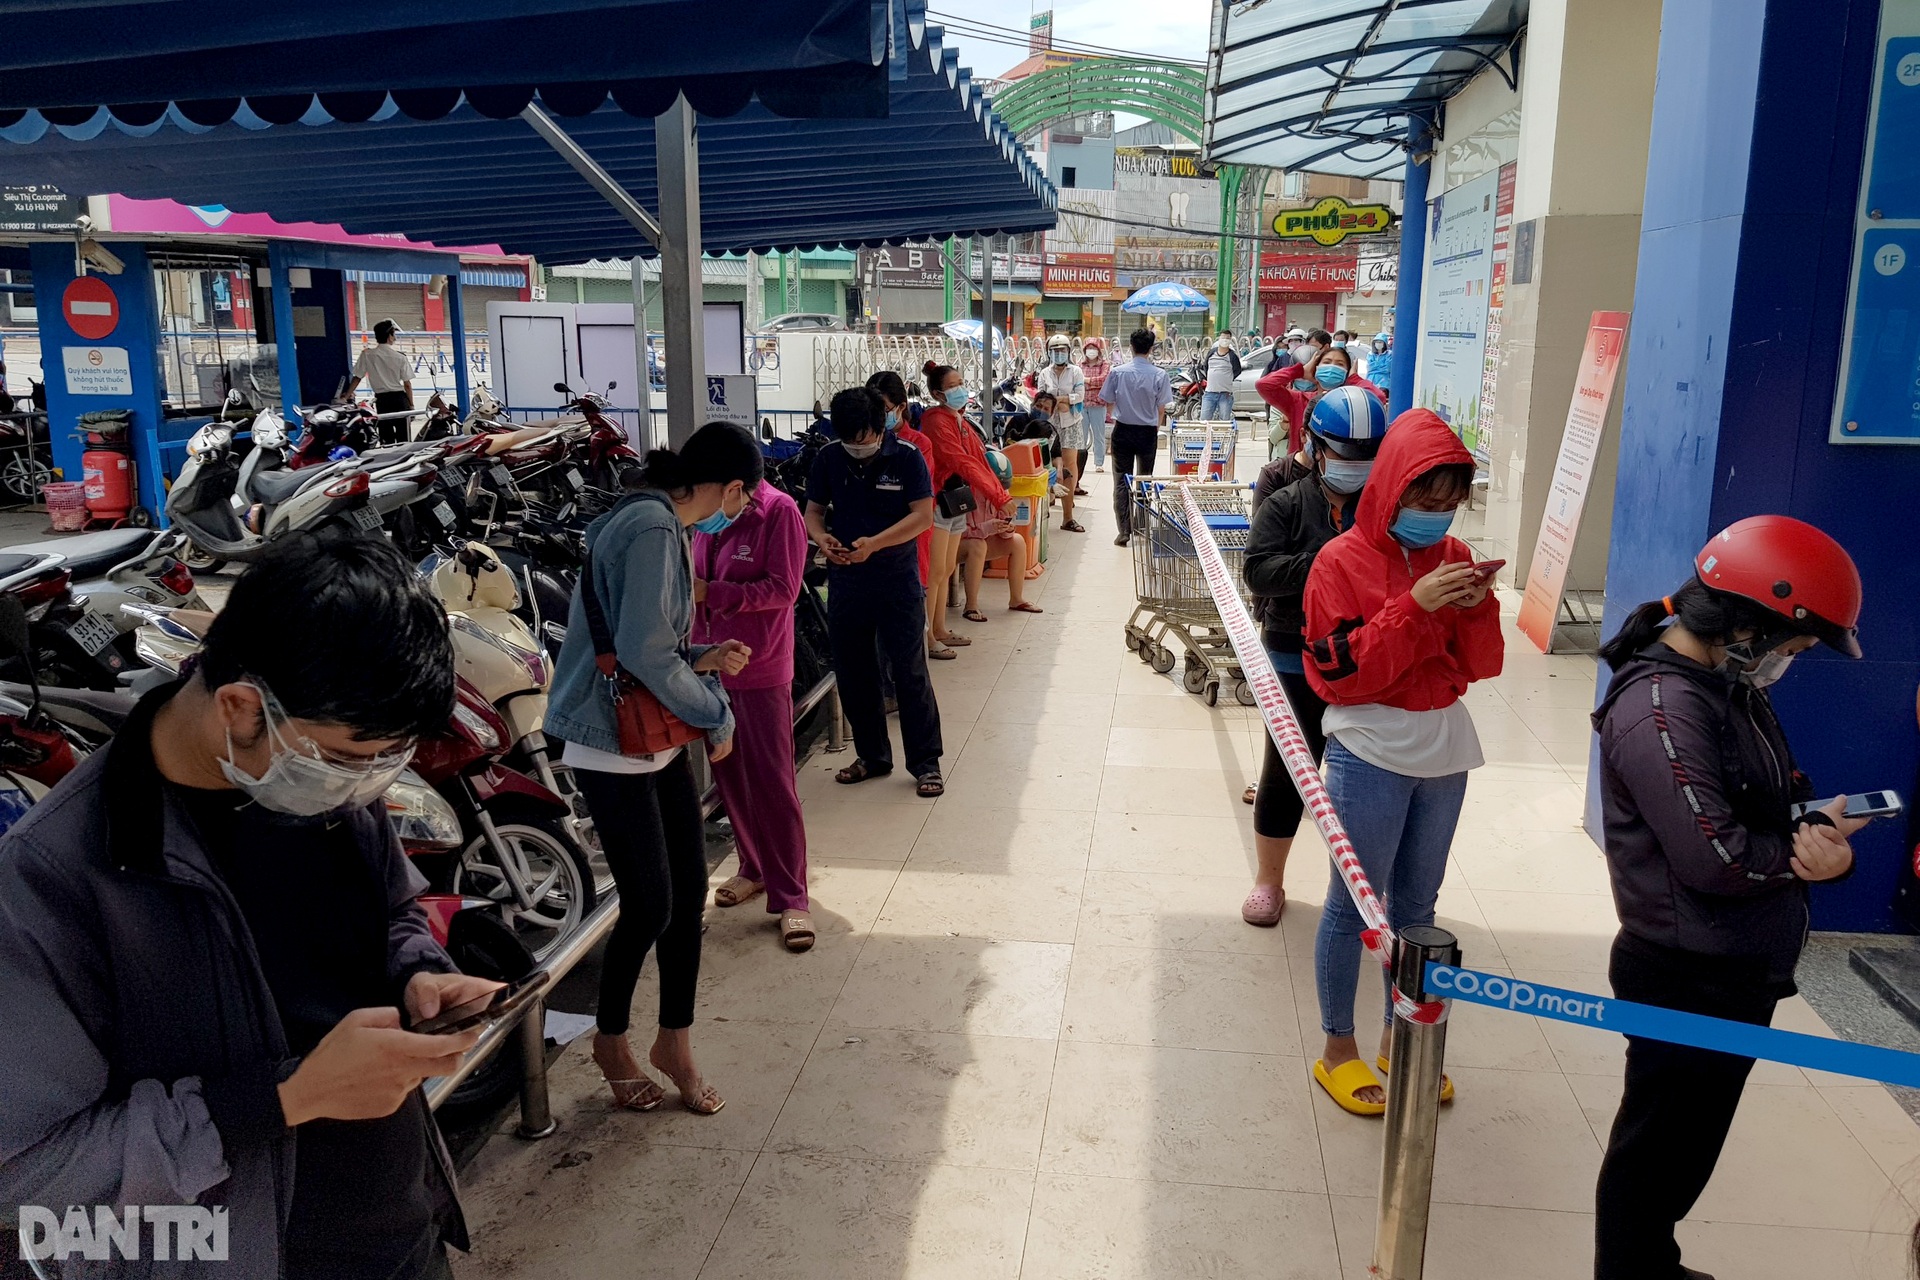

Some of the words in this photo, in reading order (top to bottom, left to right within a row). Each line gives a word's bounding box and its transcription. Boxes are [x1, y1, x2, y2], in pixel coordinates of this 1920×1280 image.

[1903, 64, 1920, 77] 2F
[1115, 155, 1138, 172] NHA
[1140, 157, 1168, 174] KHOA
[1881, 254, 1899, 267] 1F
[1048, 268, 1077, 282] MINH
[1266, 266, 1297, 280] KHOA
